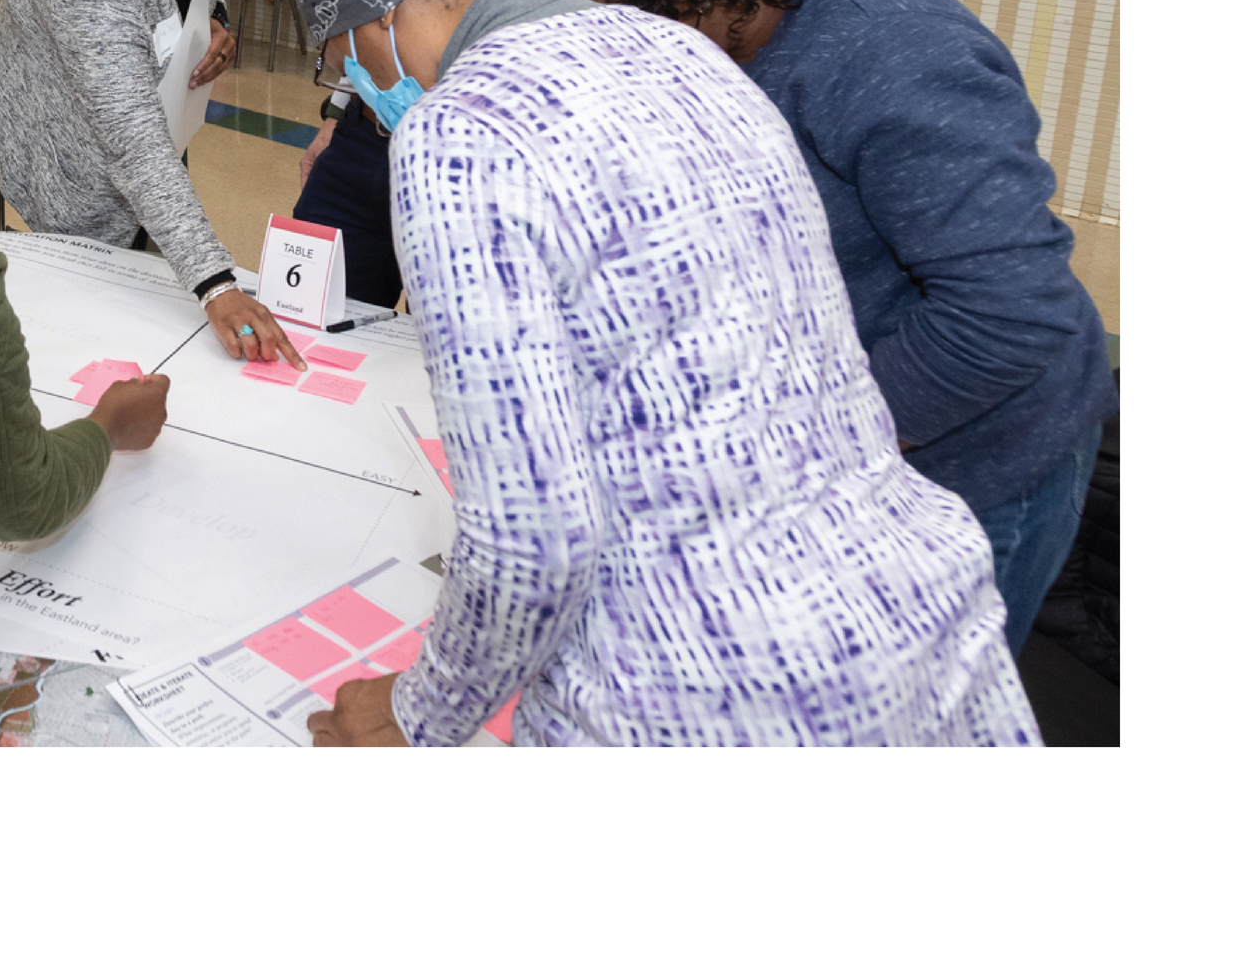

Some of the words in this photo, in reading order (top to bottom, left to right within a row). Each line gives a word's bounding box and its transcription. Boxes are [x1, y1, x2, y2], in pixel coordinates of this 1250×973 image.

[283, 242, 314, 259] TABLE
[286, 263, 302, 288] 6
[276, 300, 304, 314] Eastland
[361, 469, 398, 484] EASY
[130, 490, 258, 541] Develop
[0, 592, 13, 604] in
[15, 598, 38, 612] the
[40, 606, 100, 633] Eastland
[100, 628, 141, 646] area?
